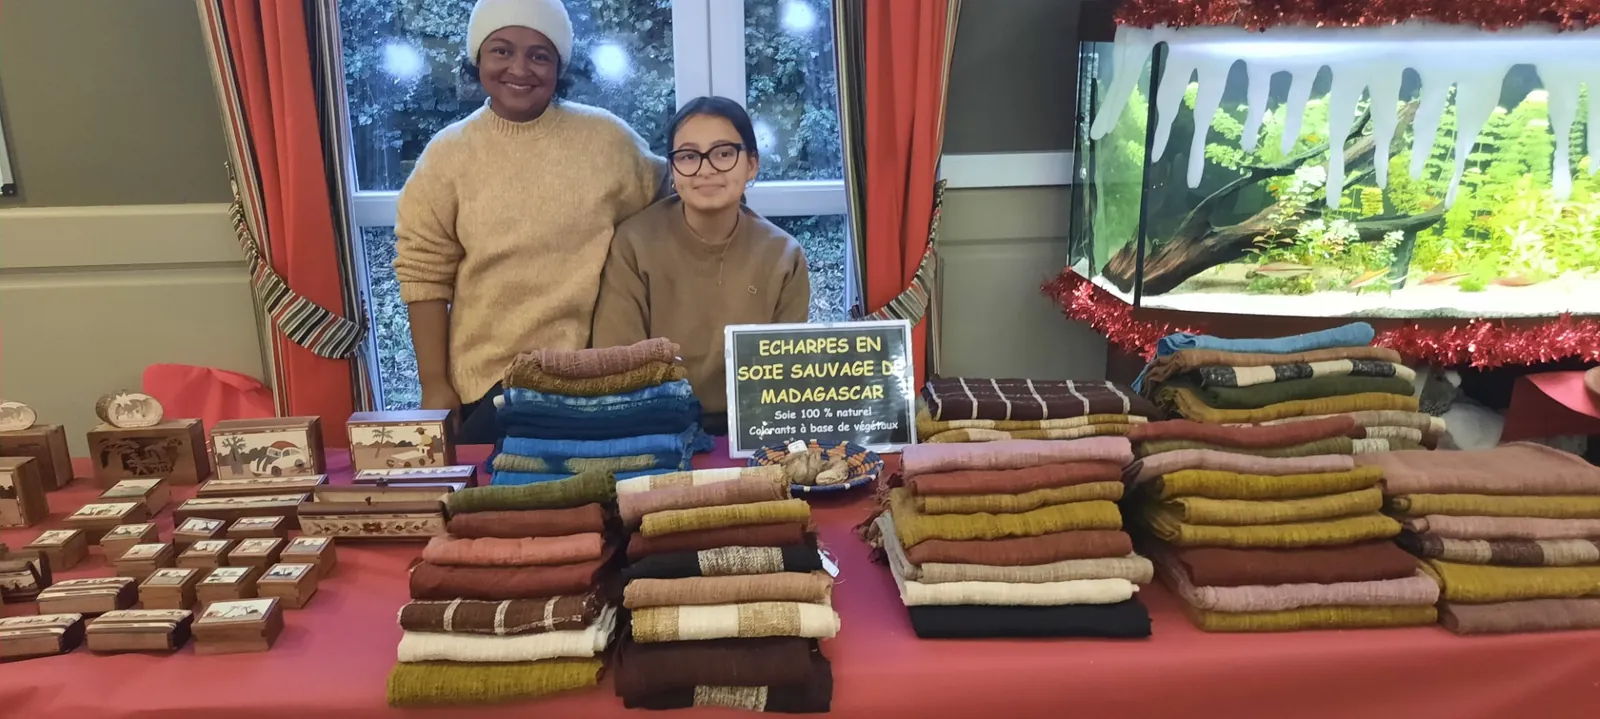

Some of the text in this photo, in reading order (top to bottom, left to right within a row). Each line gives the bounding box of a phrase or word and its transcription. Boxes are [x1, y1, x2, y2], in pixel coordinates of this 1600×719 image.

[759, 336, 882, 356] ECHARPES EN
[737, 364, 784, 381] SOIE
[790, 360, 875, 379] SAUVAGE
[760, 385, 885, 404] MADAGASCAR
[774, 406, 872, 420] Soie 100 % naturel
[749, 420, 899, 436] Colorants à base de végétaux
